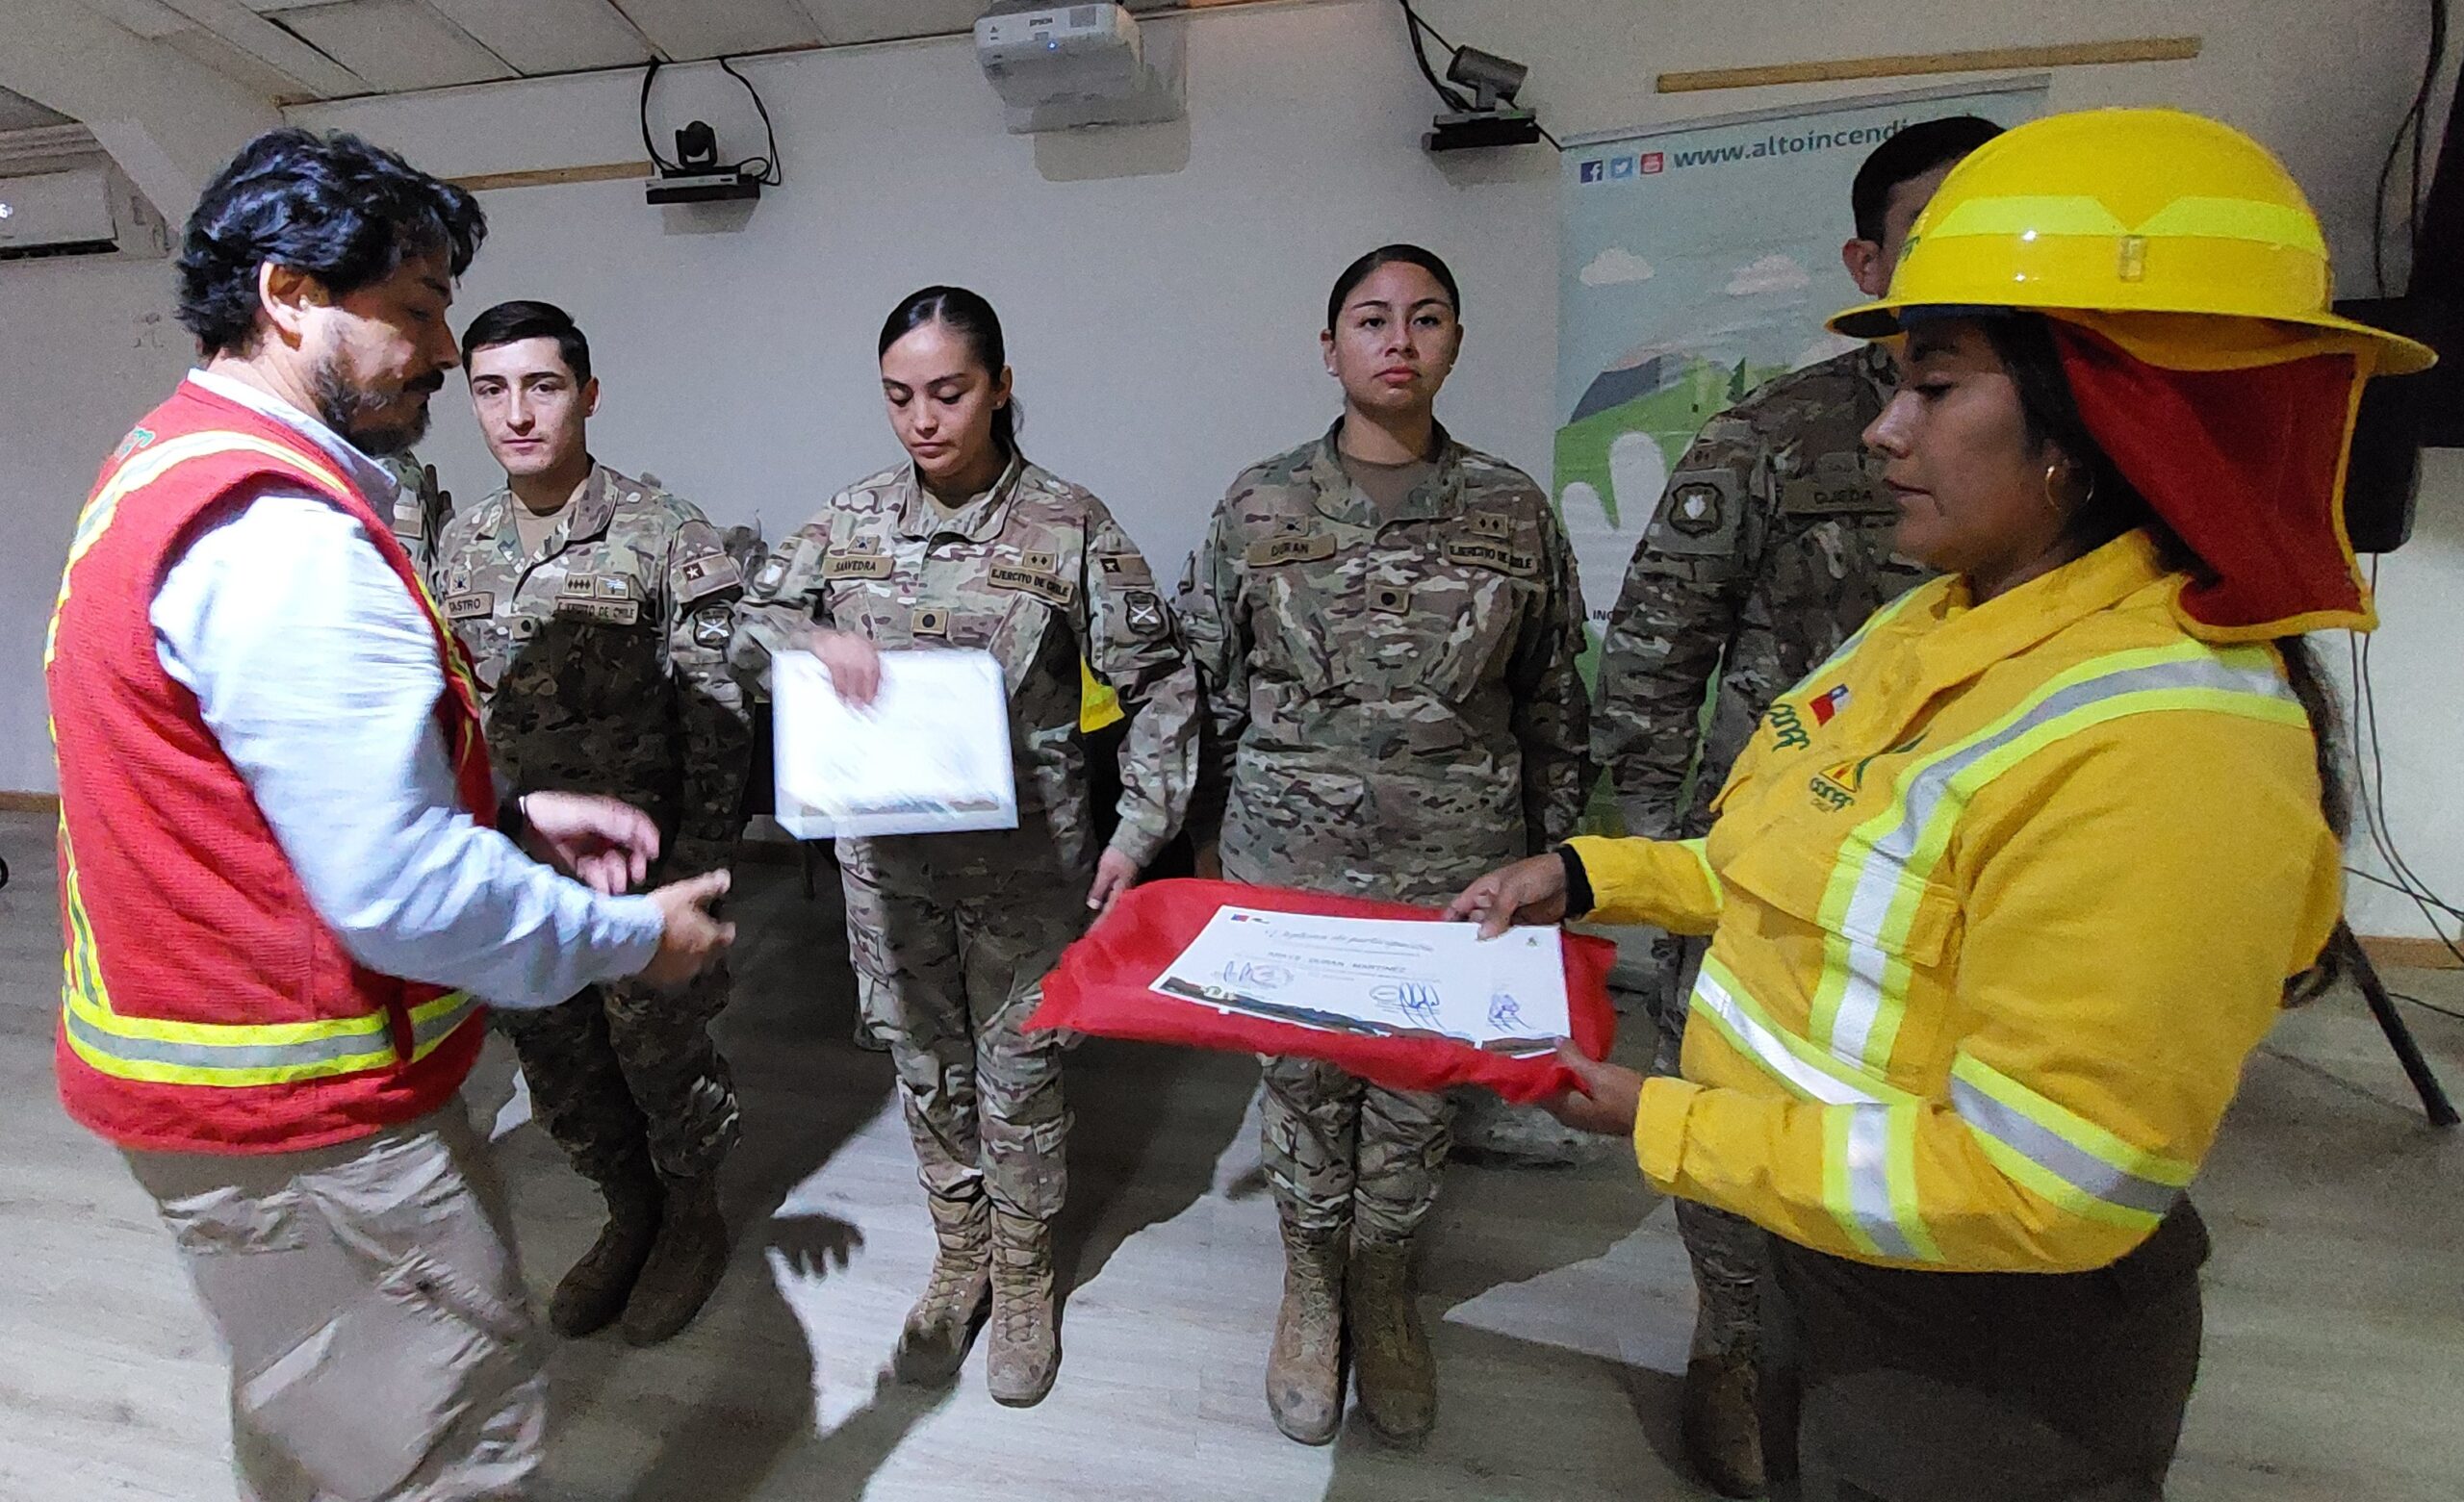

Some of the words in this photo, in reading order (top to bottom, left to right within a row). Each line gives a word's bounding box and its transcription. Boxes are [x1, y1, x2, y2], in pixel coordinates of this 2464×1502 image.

[1029, 17, 1053, 27] EPSON
[991, 569, 1032, 584] EJERCITO
[1034, 575, 1045, 588] DE
[1046, 581, 1069, 597] CHILE
